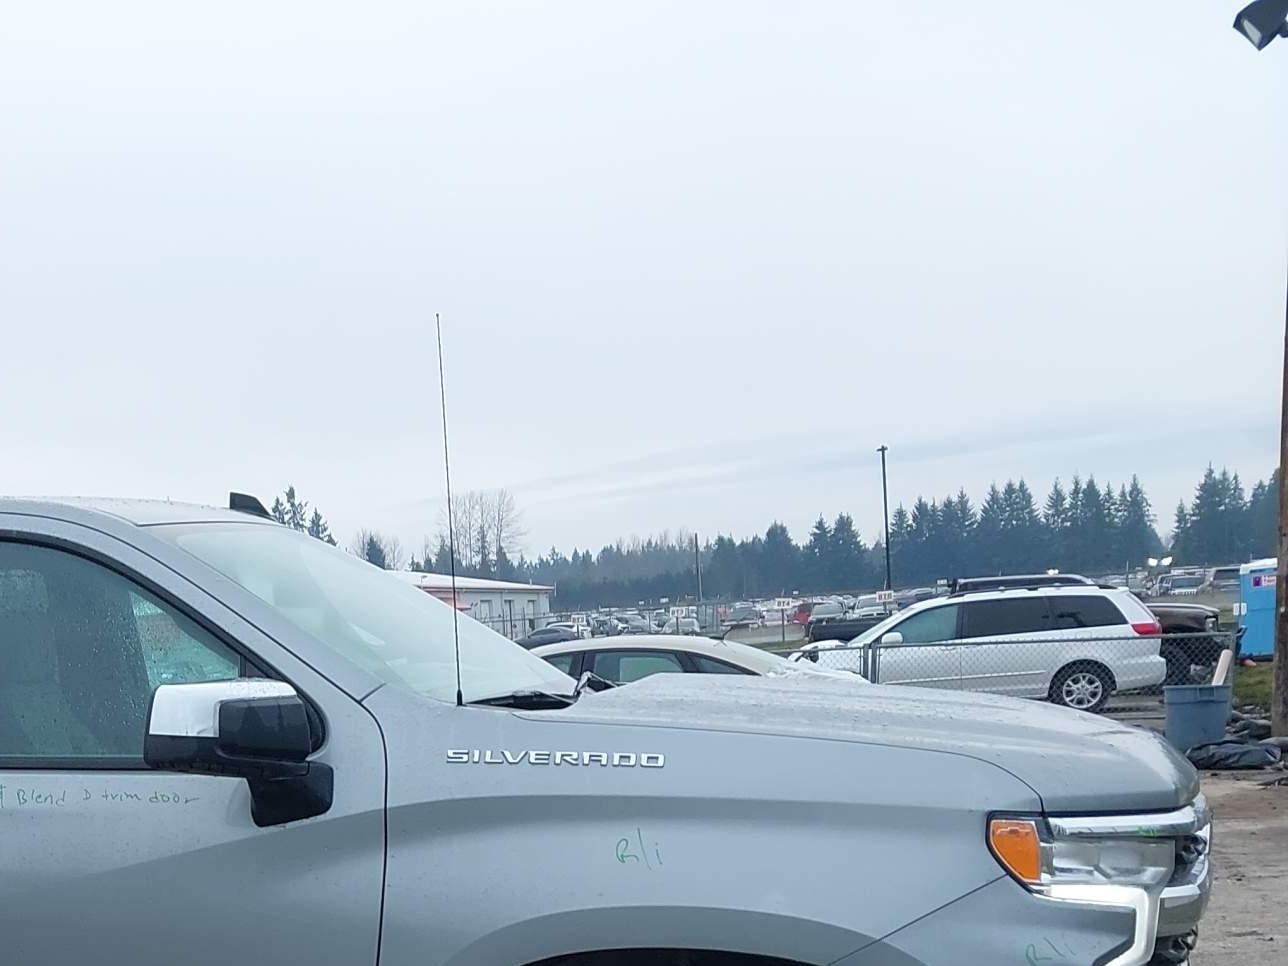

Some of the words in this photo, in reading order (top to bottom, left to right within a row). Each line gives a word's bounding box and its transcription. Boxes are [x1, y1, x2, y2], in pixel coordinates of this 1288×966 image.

[447, 749, 665, 768] SILVERADO
[16, 788, 66, 807] Blend
[101, 788, 142, 801] trim
[149, 791, 200, 804] door
